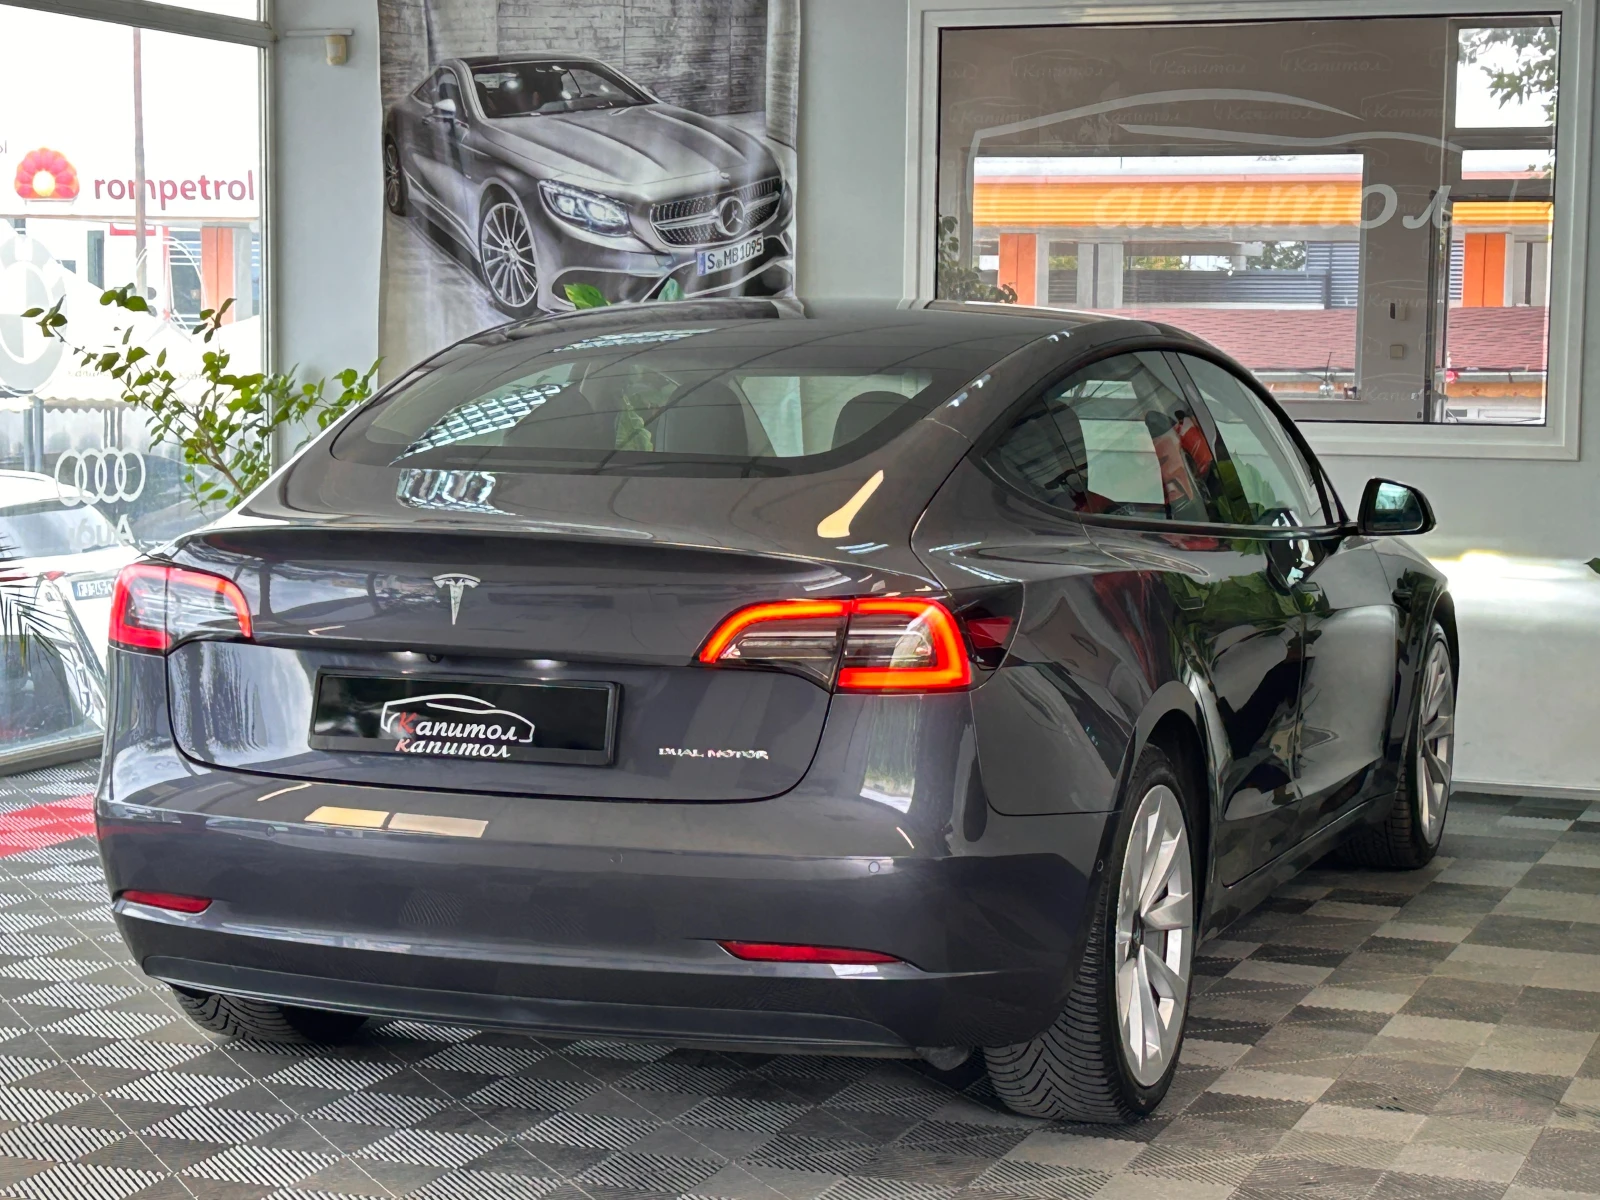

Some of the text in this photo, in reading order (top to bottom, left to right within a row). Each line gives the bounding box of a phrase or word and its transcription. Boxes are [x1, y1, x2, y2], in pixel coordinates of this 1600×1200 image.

[94, 169, 254, 210] rompetrol
[397, 711, 518, 741] Капитол
[658, 747, 769, 760] DUAL MOTOR
